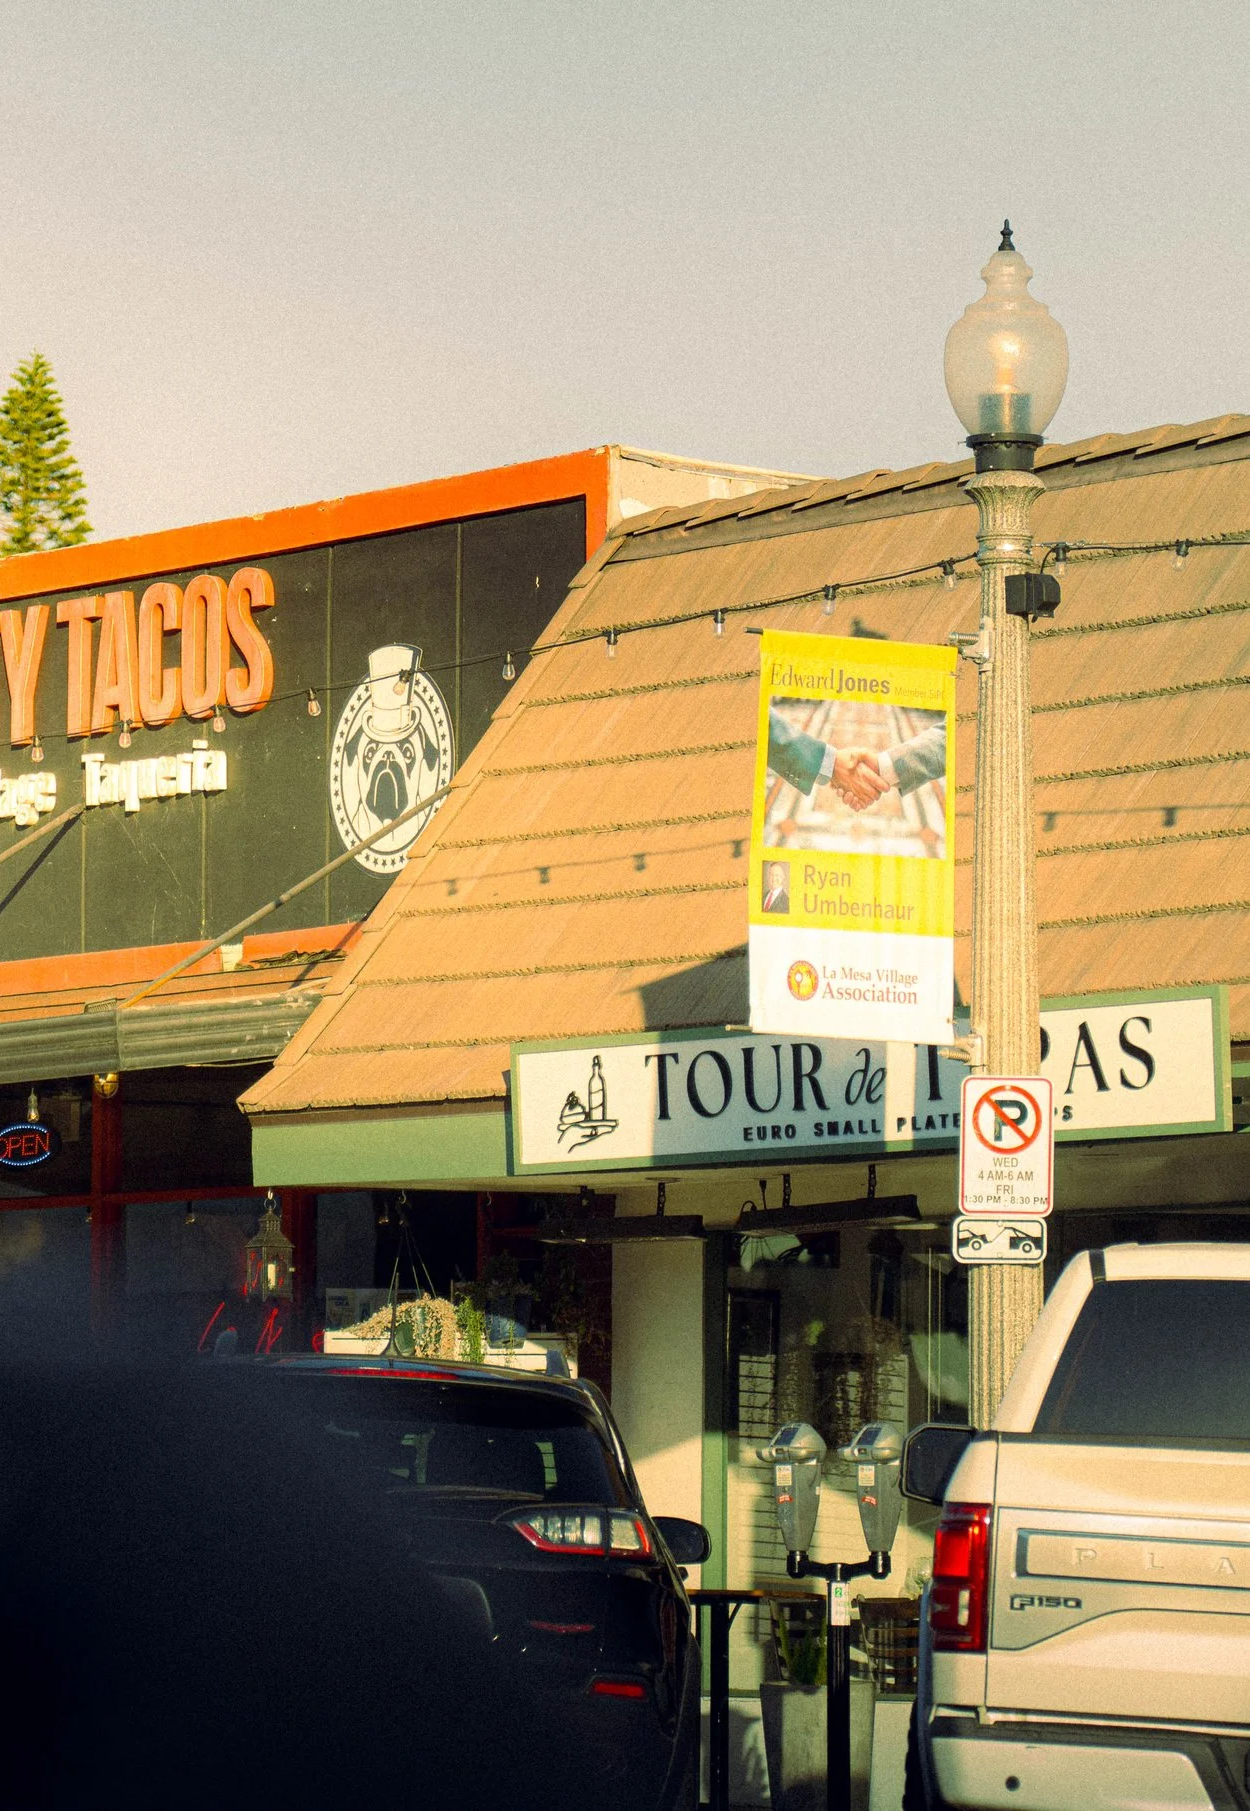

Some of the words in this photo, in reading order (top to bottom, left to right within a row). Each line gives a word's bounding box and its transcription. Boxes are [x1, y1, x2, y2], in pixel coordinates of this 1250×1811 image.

[57, 567, 274, 739] TACOS
[770, 663, 834, 690] Edward
[837, 669, 890, 694] Jones
[81, 740, 227, 812] Taqueria
[803, 864, 852, 891] Ryan
[803, 893, 915, 921] Umbenhaur
[823, 966, 836, 979] La
[841, 967, 871, 981] Mesa
[876, 969, 918, 988] Village
[822, 982, 918, 1005] Association
[645, 1042, 830, 1120] TOUR
[845, 1048, 887, 1106] de
[743, 1124, 797, 1141] EURO
[813, 1118, 882, 1138] SMALL
[897, 1113, 960, 1133] PLATE
[978, 1171, 984, 1181] 4
[1016, 1171, 1034, 1181] AM
[993, 1157, 1019, 1168] WED
[964, 1195, 983, 1204] 1:30
[986, 1195, 1001, 1204] PM
[1010, 1196, 1030, 1205] 8:30
[1033, 1197, 1048, 1205] PM
[996, 1185, 1014, 1195] FRI
